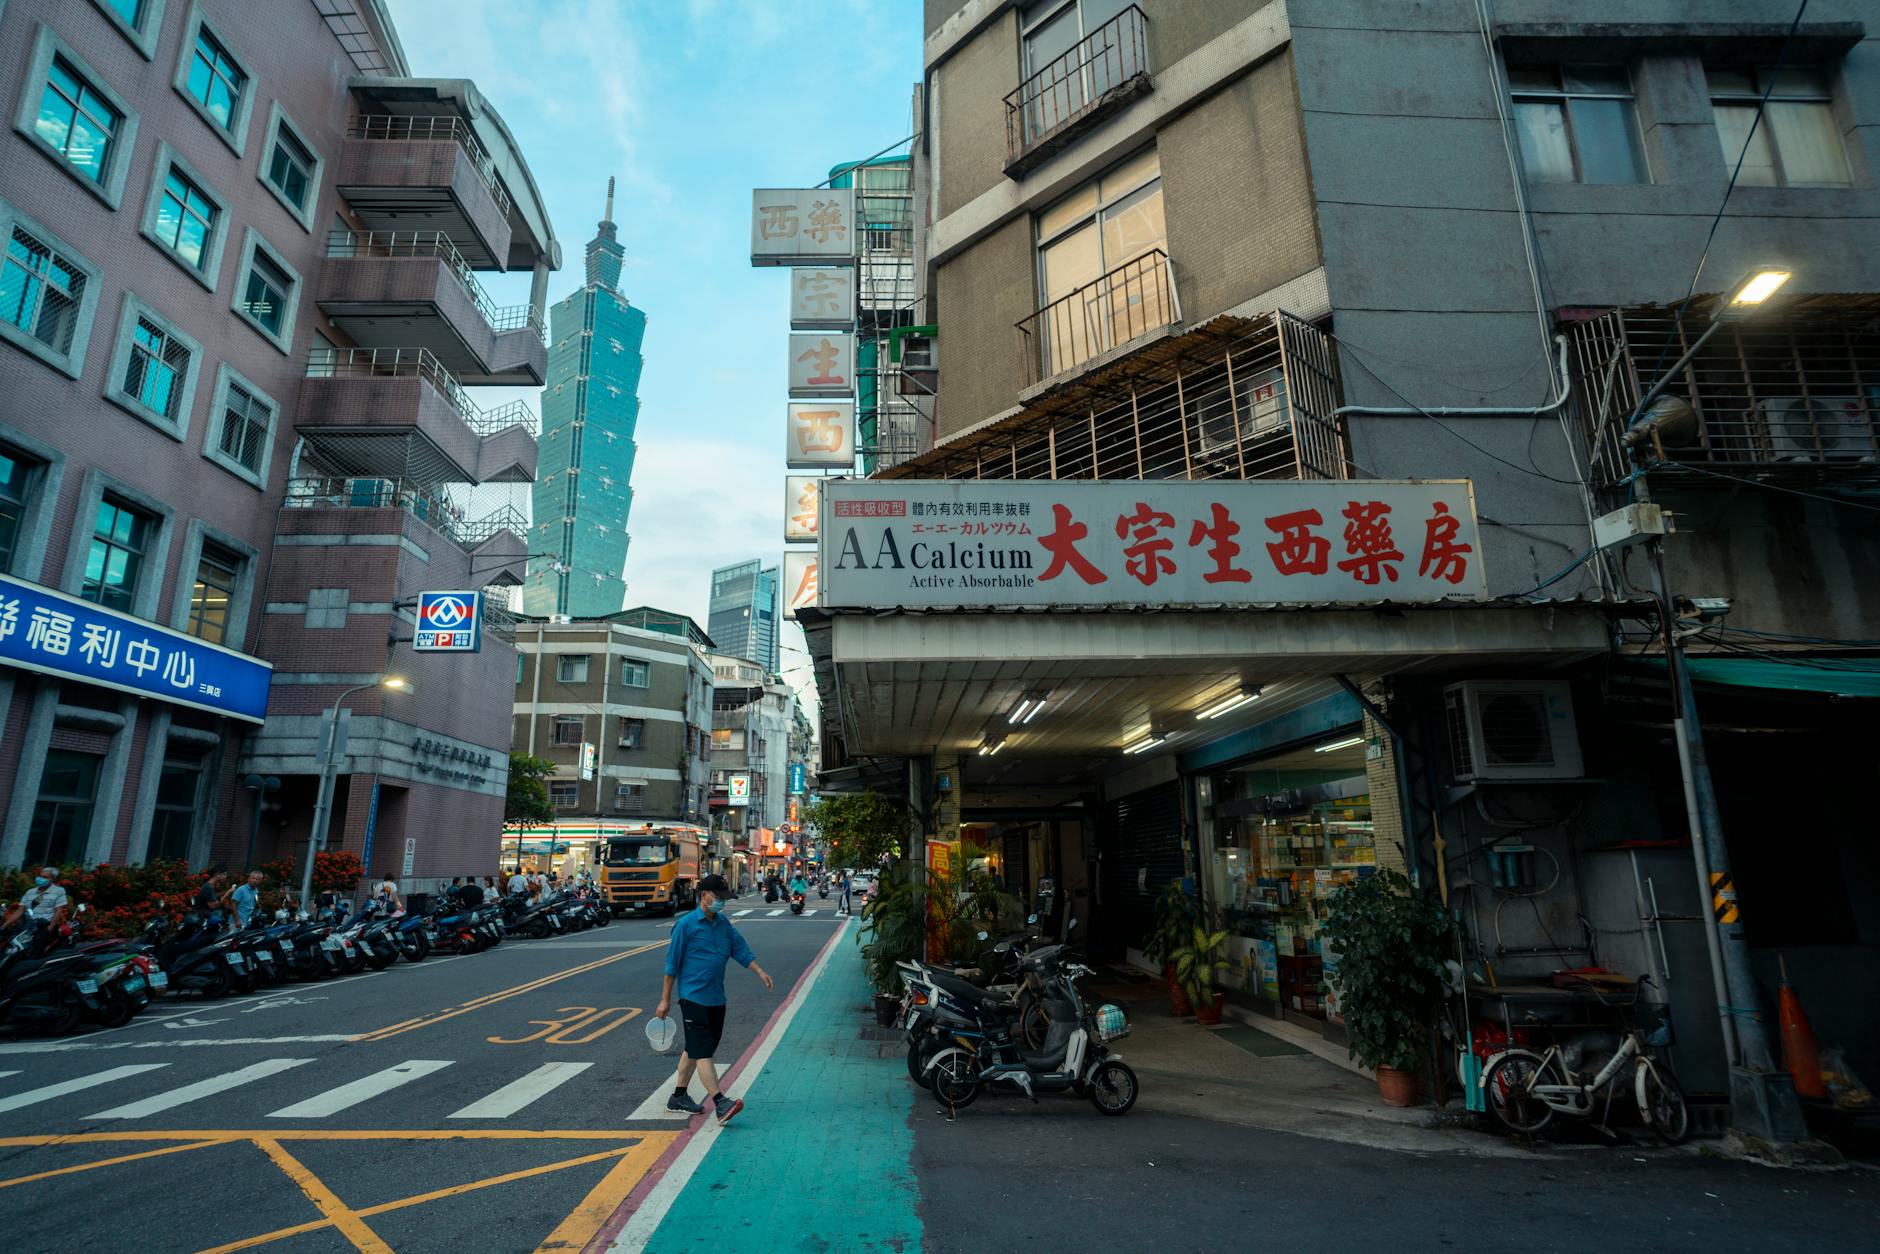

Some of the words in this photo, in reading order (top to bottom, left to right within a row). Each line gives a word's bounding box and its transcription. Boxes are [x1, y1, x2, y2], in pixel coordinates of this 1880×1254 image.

[759, 200, 847, 243] 西藥
[836, 501, 905, 517] 活性吸收型
[910, 542, 1033, 569] Calcium
[1037, 501, 1473, 586] 大宗生西藥房
[910, 575, 954, 588] Active
[958, 575, 1034, 588] Absorbable
[438, 633, 450, 646] P
[486, 1006, 643, 1044] 30
